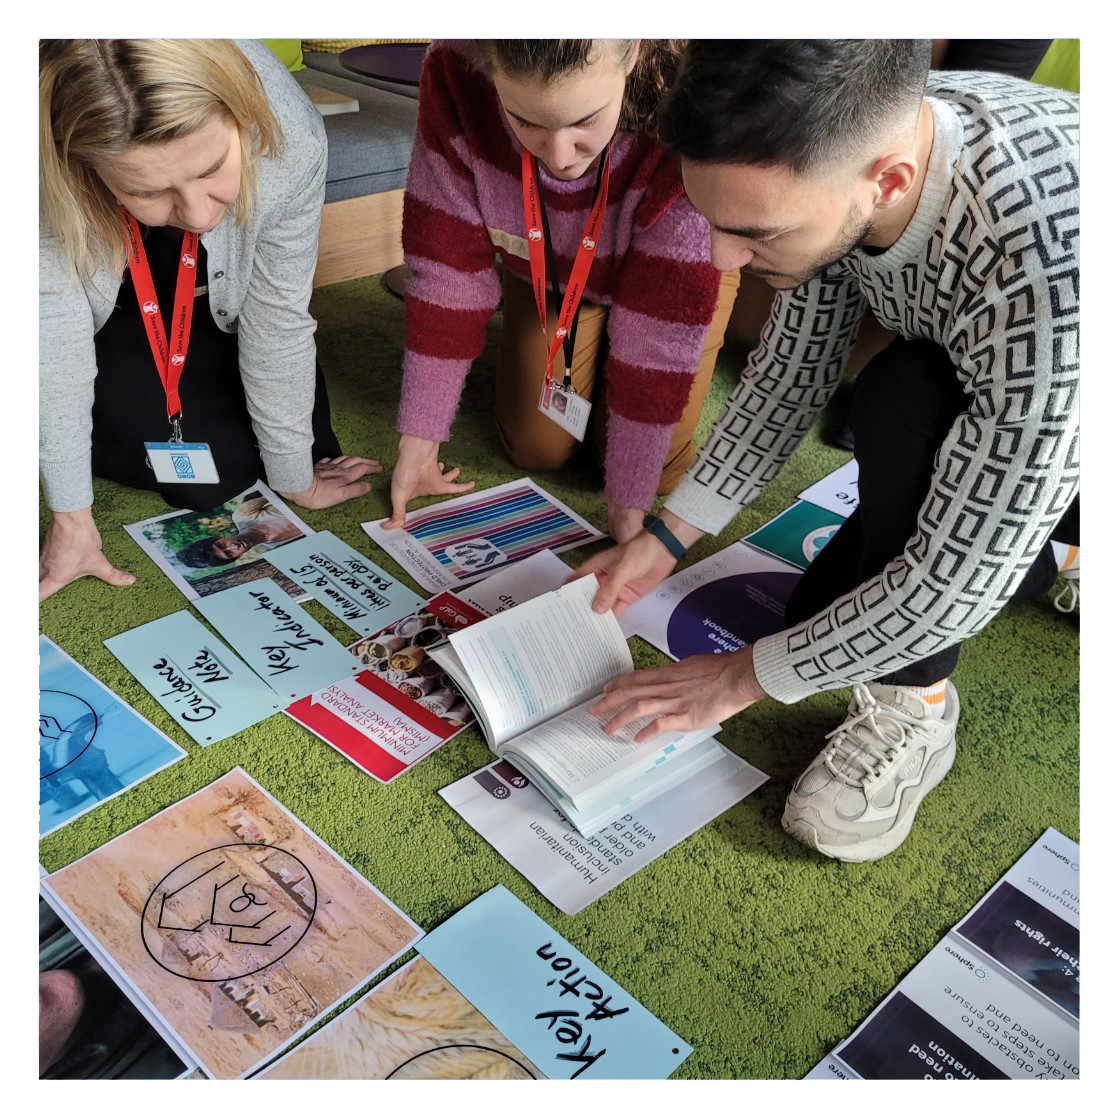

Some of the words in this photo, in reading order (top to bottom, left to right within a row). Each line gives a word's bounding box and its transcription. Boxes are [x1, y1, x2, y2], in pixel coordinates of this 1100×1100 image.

[249, 591, 323, 650] Indicator
[261, 646, 299, 676] Key
[153, 658, 216, 722] Guidance
[321, 692, 371, 726] STANDARD
[363, 708, 402, 737] MARKET
[370, 722, 410, 756] MINIMUM
[393, 717, 430, 742] (MISMA)
[400, 736, 418, 750] FOR
[605, 834, 633, 857] older
[622, 832, 645, 850] and
[633, 823, 656, 842] with
[530, 821, 598, 884] Humanitarian
[563, 833, 611, 875] inclusion
[1043, 844, 1071, 865] Sphere
[1014, 919, 1050, 947] rights
[944, 946, 975, 971] Sphere
[536, 942, 629, 1020] Action
[944, 986, 984, 1020] ensure
[986, 1003, 1010, 1023] and
[961, 1014, 974, 1028] to
[987, 1019, 1000, 1032] to
[535, 1010, 606, 1080] Key
[976, 1026, 1034, 1073] obstacles
[1002, 1031, 1036, 1059] steps
[1011, 1023, 1045, 1050] need
[908, 1043, 943, 1073] need
[1046, 1047, 1061, 1061] to
